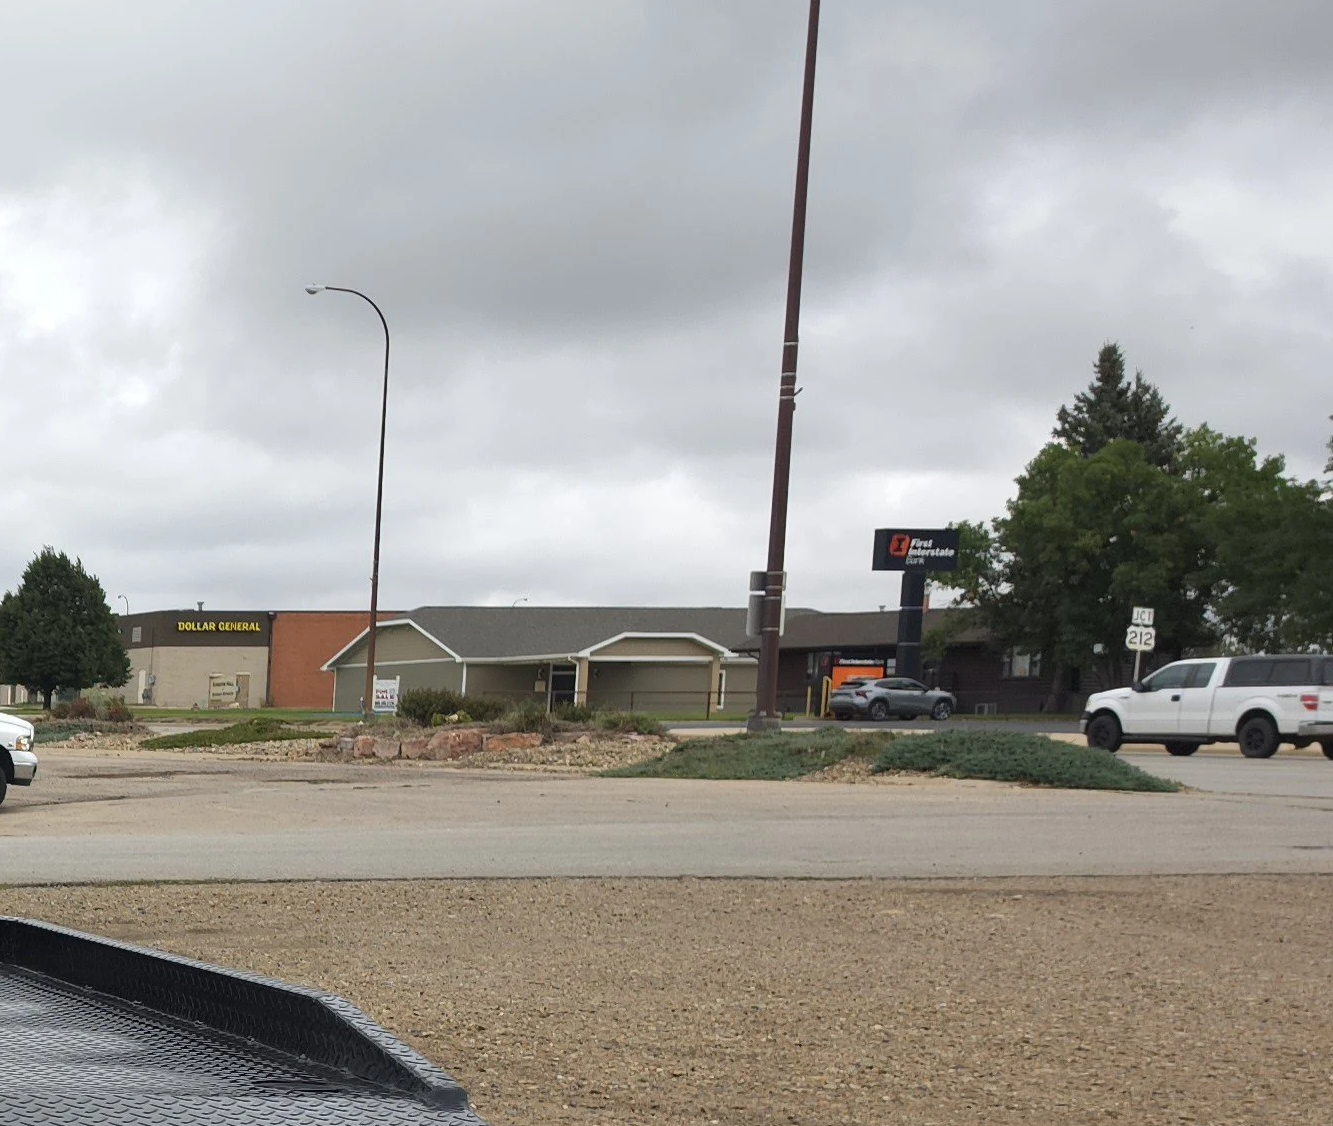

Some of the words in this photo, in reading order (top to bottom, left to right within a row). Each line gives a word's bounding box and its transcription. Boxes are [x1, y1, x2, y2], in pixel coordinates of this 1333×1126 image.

[910, 538, 933, 548] First
[908, 547, 955, 557] Interstate
[178, 621, 216, 631] DOLLAR
[218, 622, 261, 631] GENERAL
[1128, 630, 1153, 646] 212
